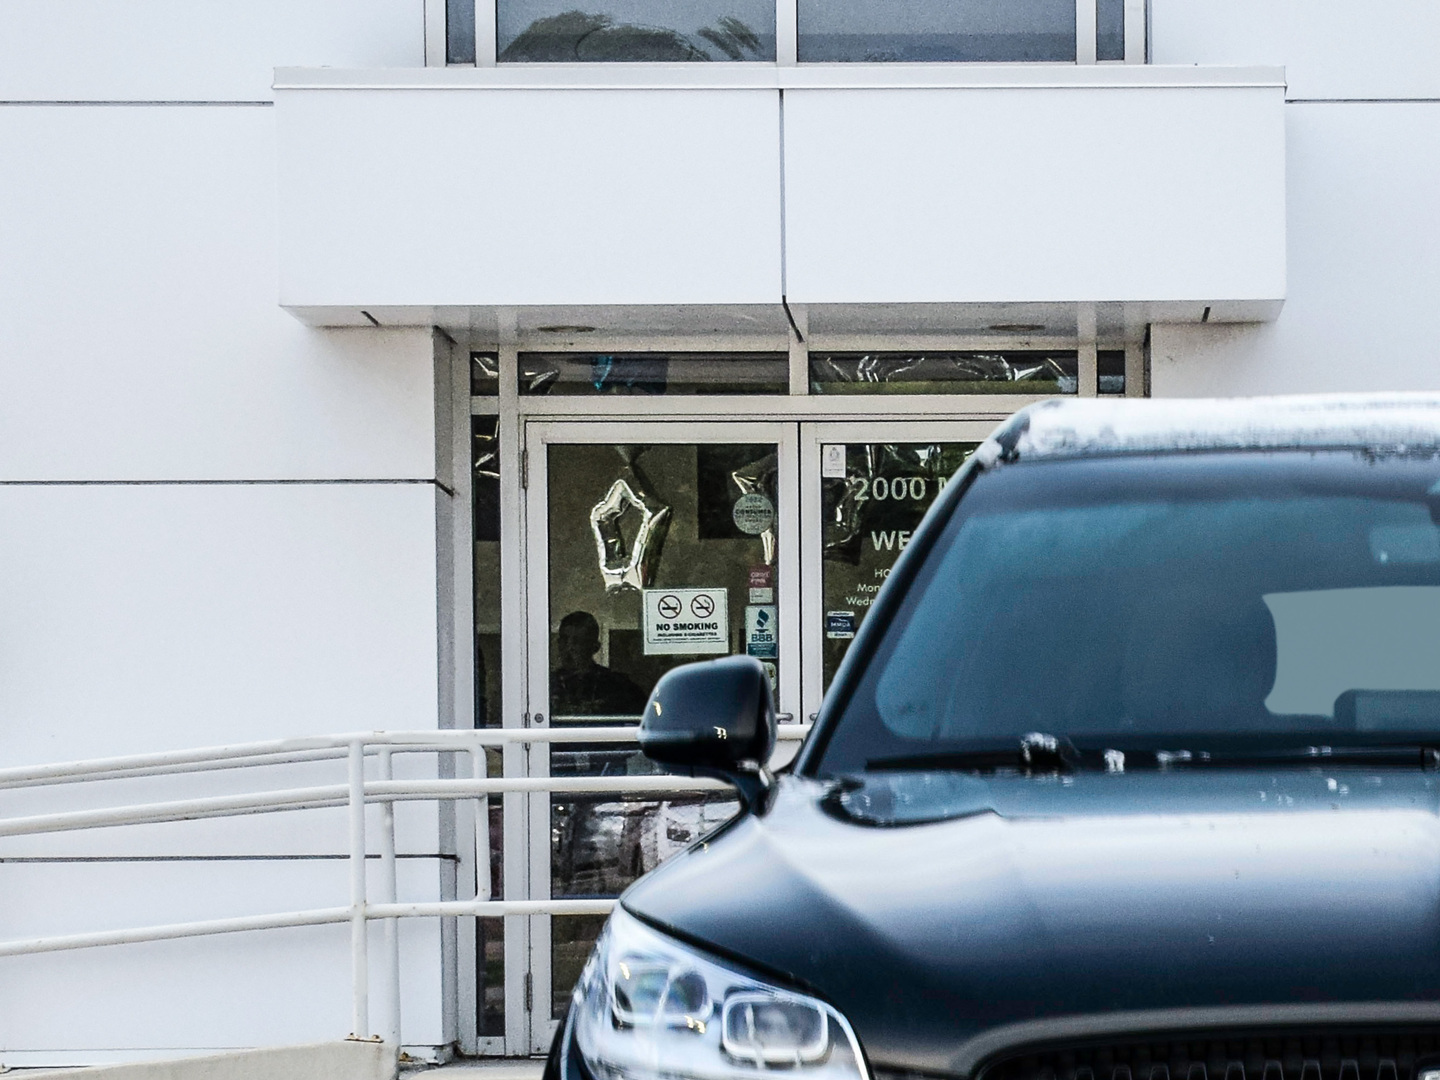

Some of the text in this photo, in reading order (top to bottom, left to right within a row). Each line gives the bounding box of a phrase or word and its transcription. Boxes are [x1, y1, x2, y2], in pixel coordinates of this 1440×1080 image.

[853, 476, 926, 501] 2000
[656, 622, 719, 632] NO SMOKING
[751, 633, 773, 643] BBB
